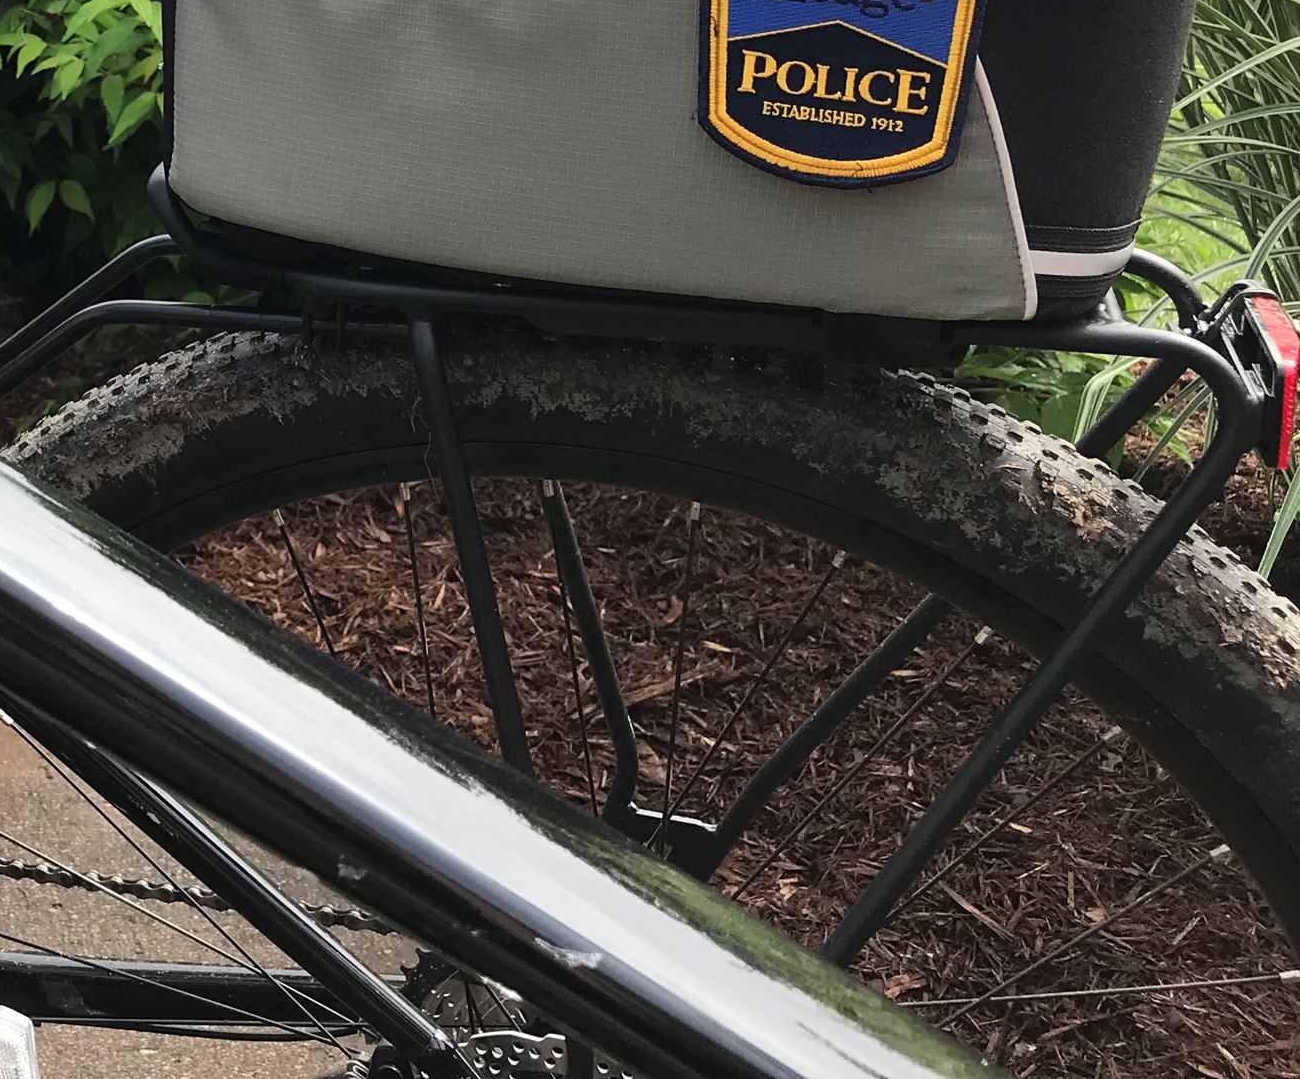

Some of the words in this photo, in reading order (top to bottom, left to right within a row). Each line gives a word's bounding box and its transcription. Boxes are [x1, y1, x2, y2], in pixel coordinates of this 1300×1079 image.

[736, 49, 932, 116] POLICE
[761, 100, 867, 128] ESTABLISHED
[870, 115, 905, 133] 1912
